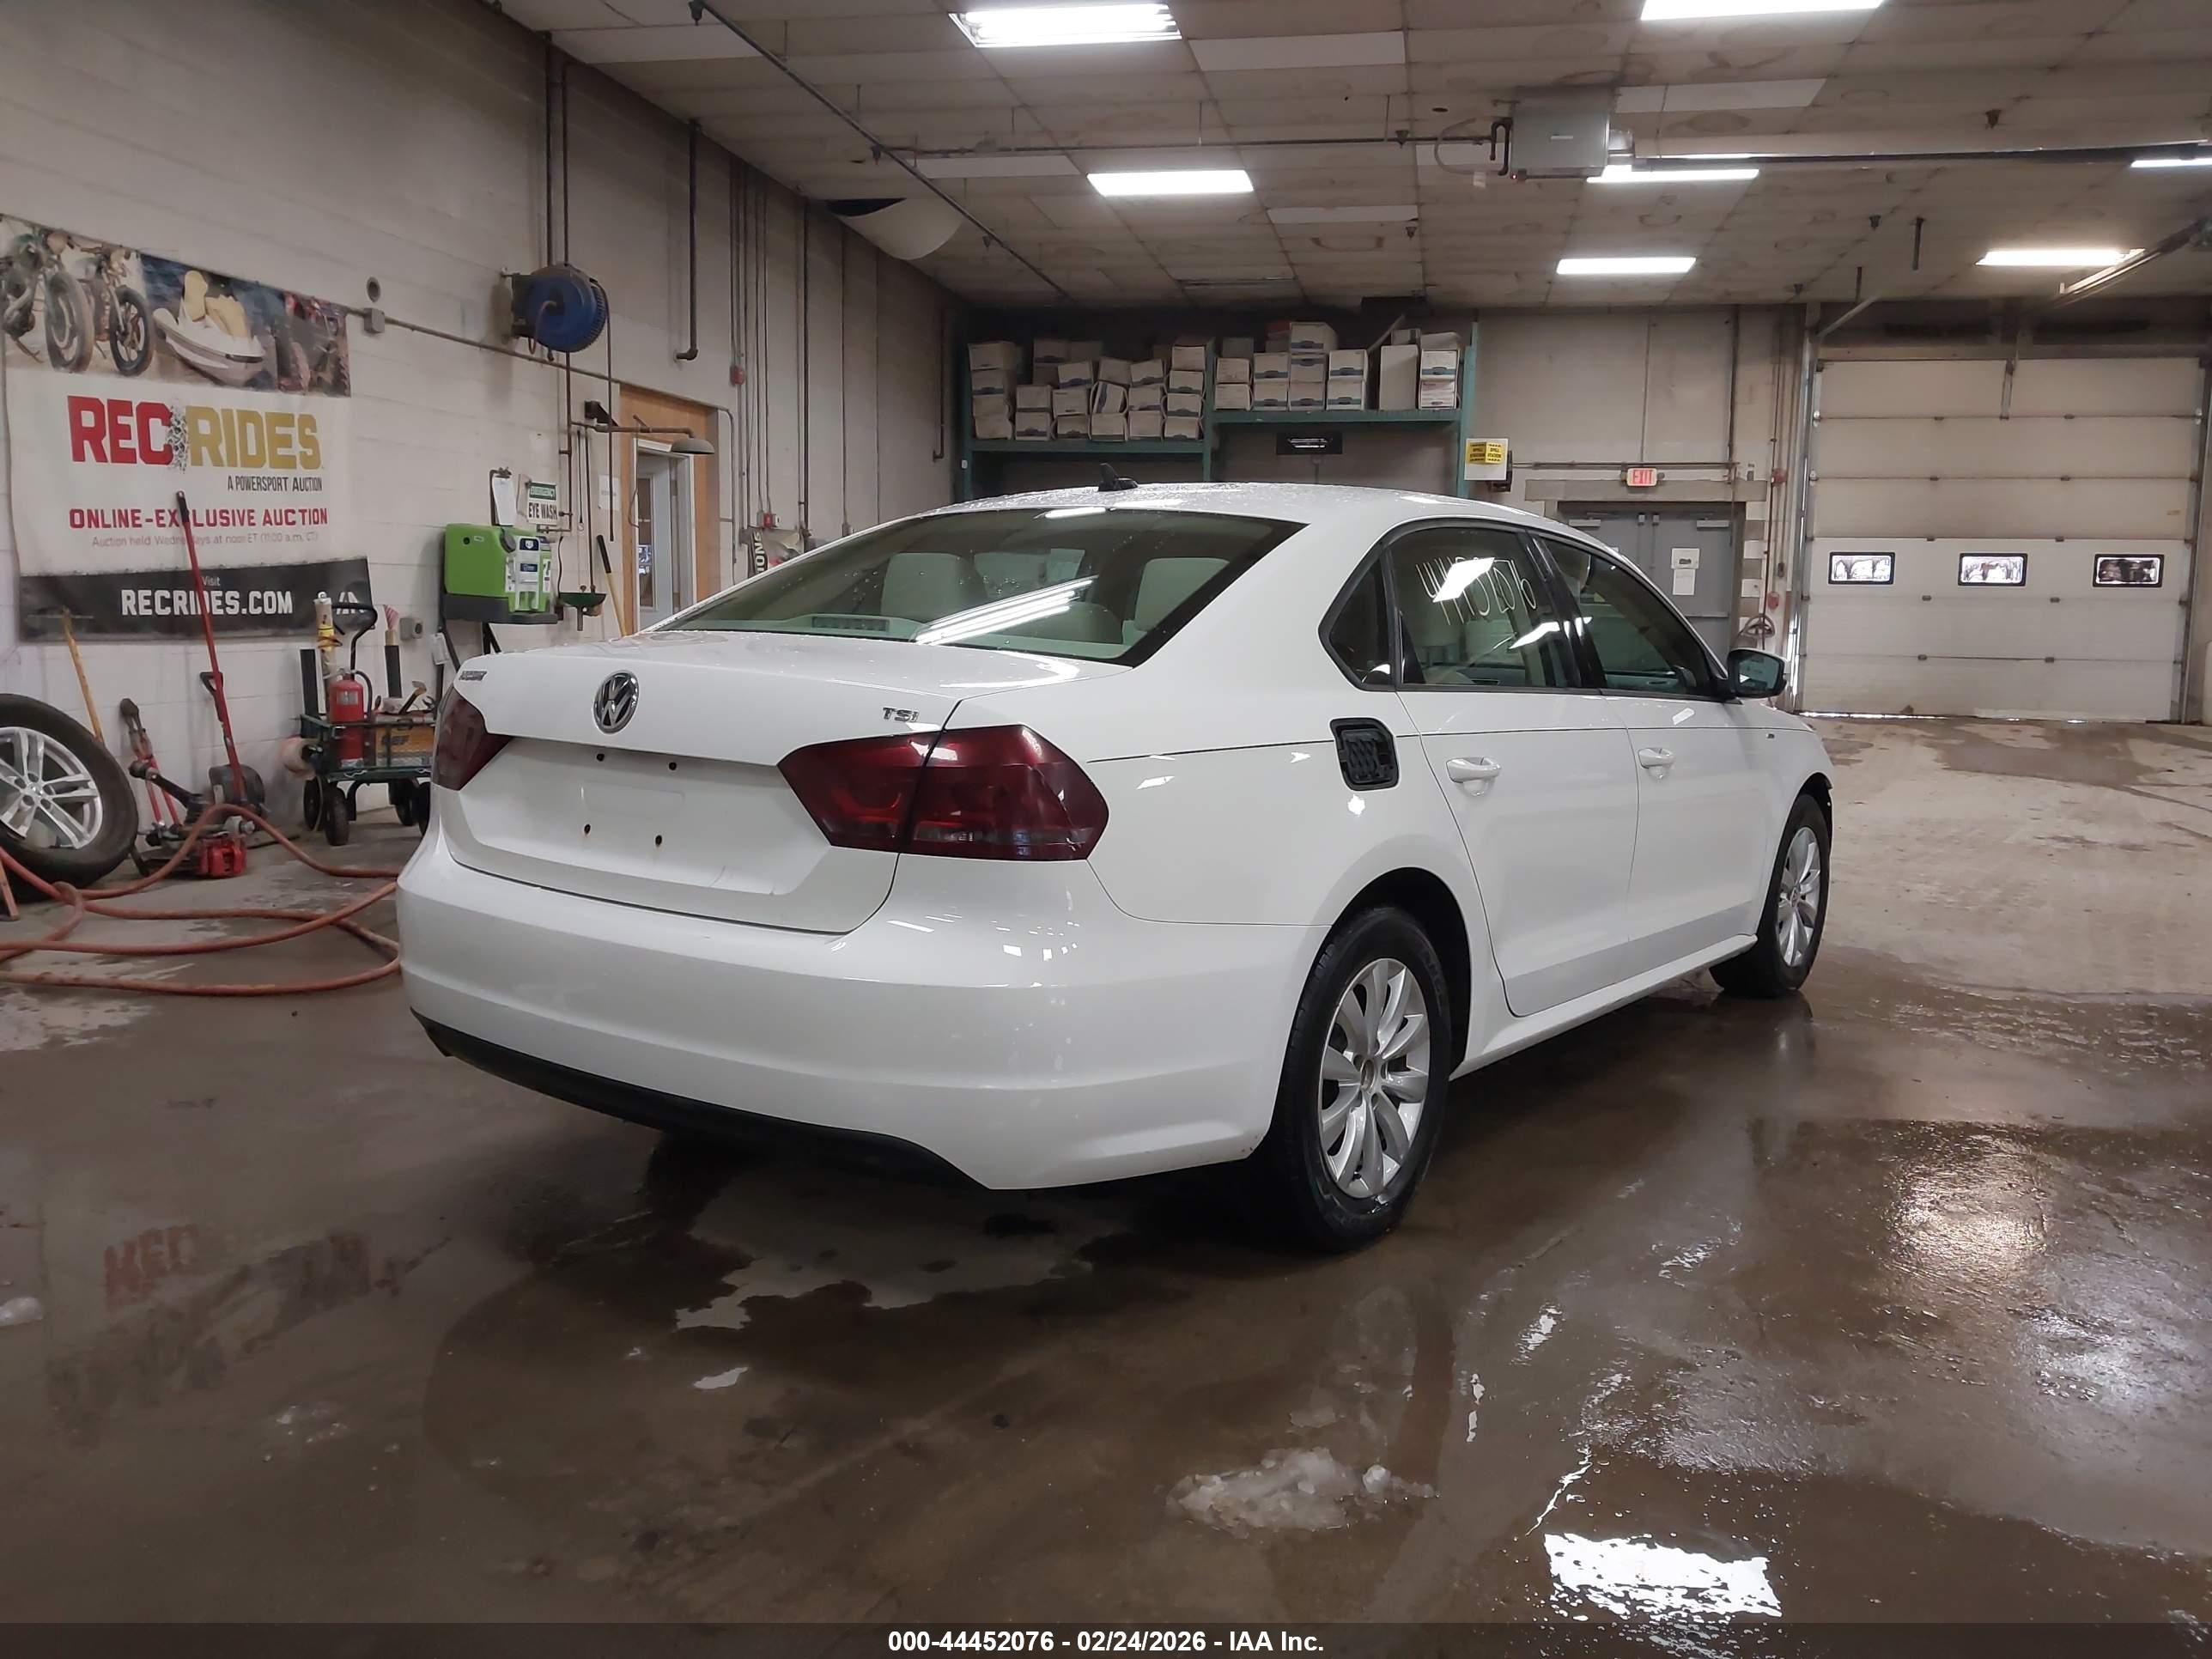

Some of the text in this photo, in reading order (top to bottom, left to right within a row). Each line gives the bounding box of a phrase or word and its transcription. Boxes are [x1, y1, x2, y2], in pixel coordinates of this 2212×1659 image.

[185, 405, 322, 470] RIDES
[228, 475, 323, 492] A POWERSPORT AUCTION
[1632, 469, 1654, 484] EXIT
[69, 507, 328, 529] ONLINE-EXLUSIVE AUCTION
[529, 502, 558, 520] EYE WASH
[130, 535, 151, 546] held
[213, 535, 222, 544] at
[201, 575, 221, 586] Visit
